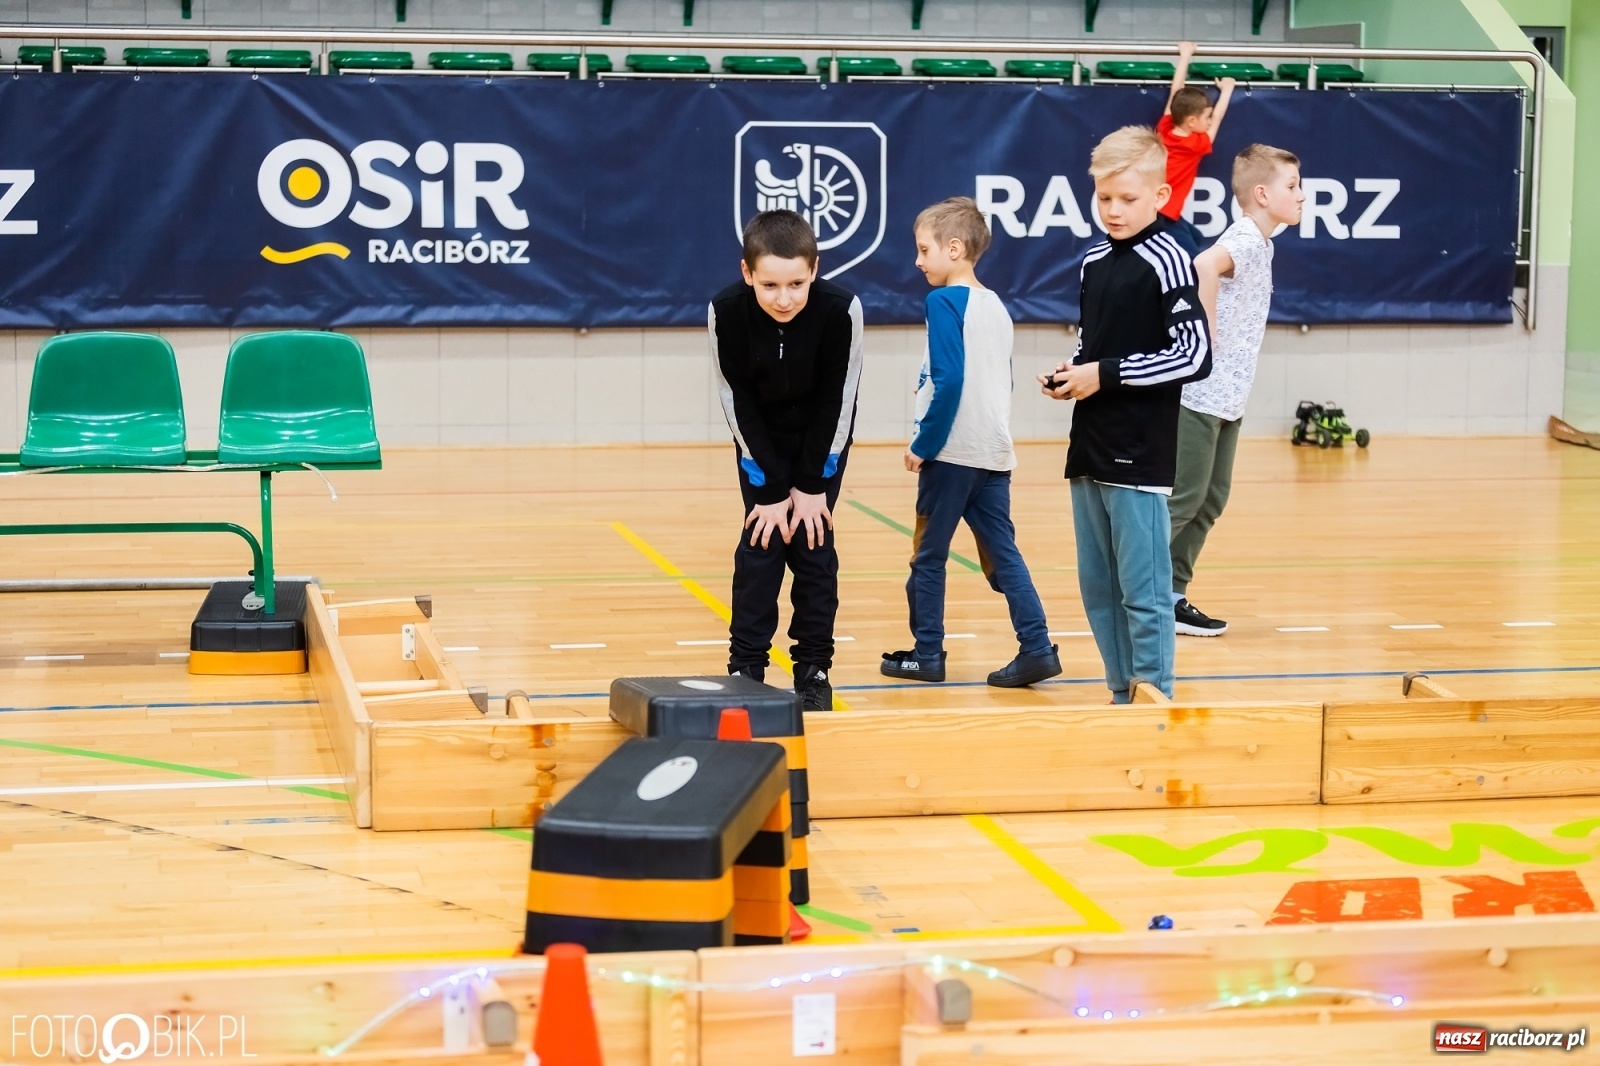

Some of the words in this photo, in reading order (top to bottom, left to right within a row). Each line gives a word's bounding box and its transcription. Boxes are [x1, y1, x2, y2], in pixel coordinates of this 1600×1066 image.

[257, 138, 530, 231] OSiR
[368, 231, 530, 265] RACIBÓRZ
[901, 661, 920, 669] NASA
